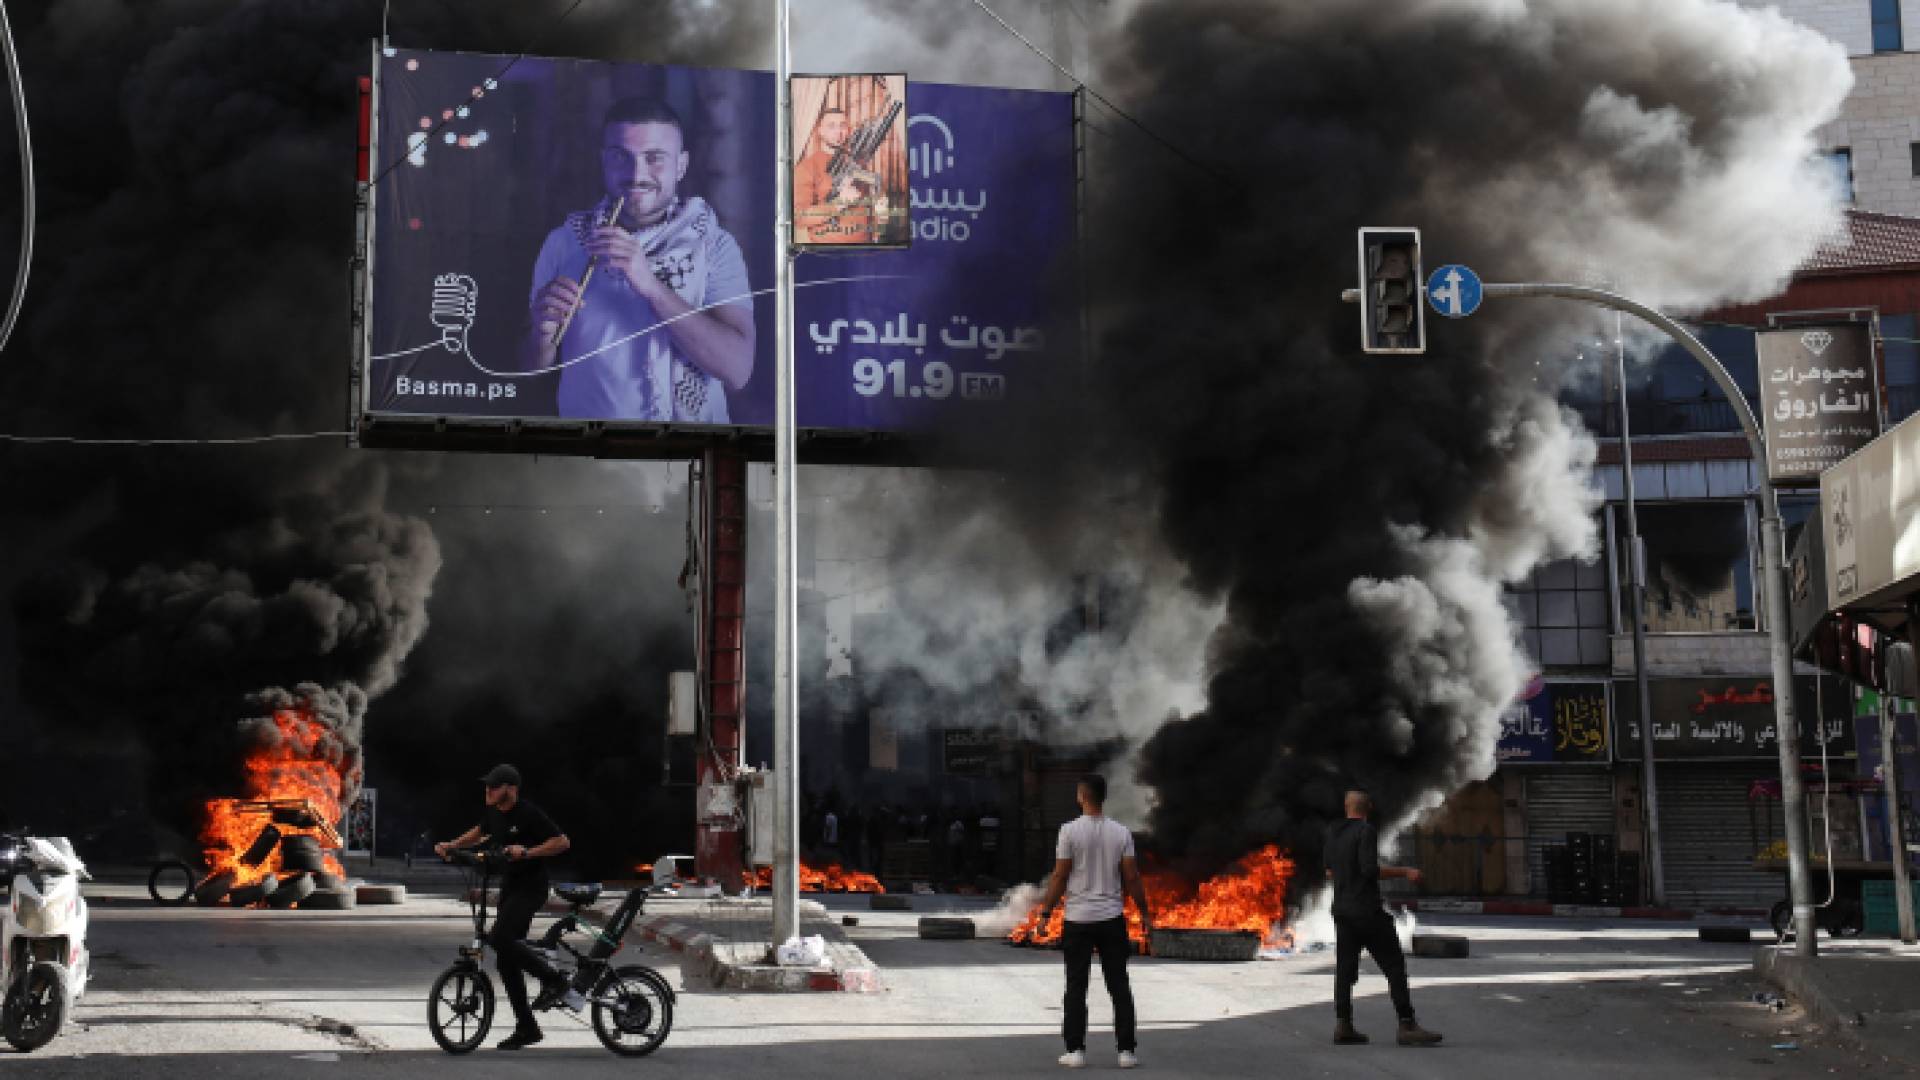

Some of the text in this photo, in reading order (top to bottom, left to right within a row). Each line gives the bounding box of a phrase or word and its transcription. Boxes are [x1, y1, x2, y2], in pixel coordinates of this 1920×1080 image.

[809, 312, 1045, 359] صوت بلدي
[395, 375, 517, 401] Basma.ps
[852, 357, 954, 398] 91.9
[1770, 366, 1866, 384] مجوهرات
[1773, 388, 1870, 421] الفاروق
